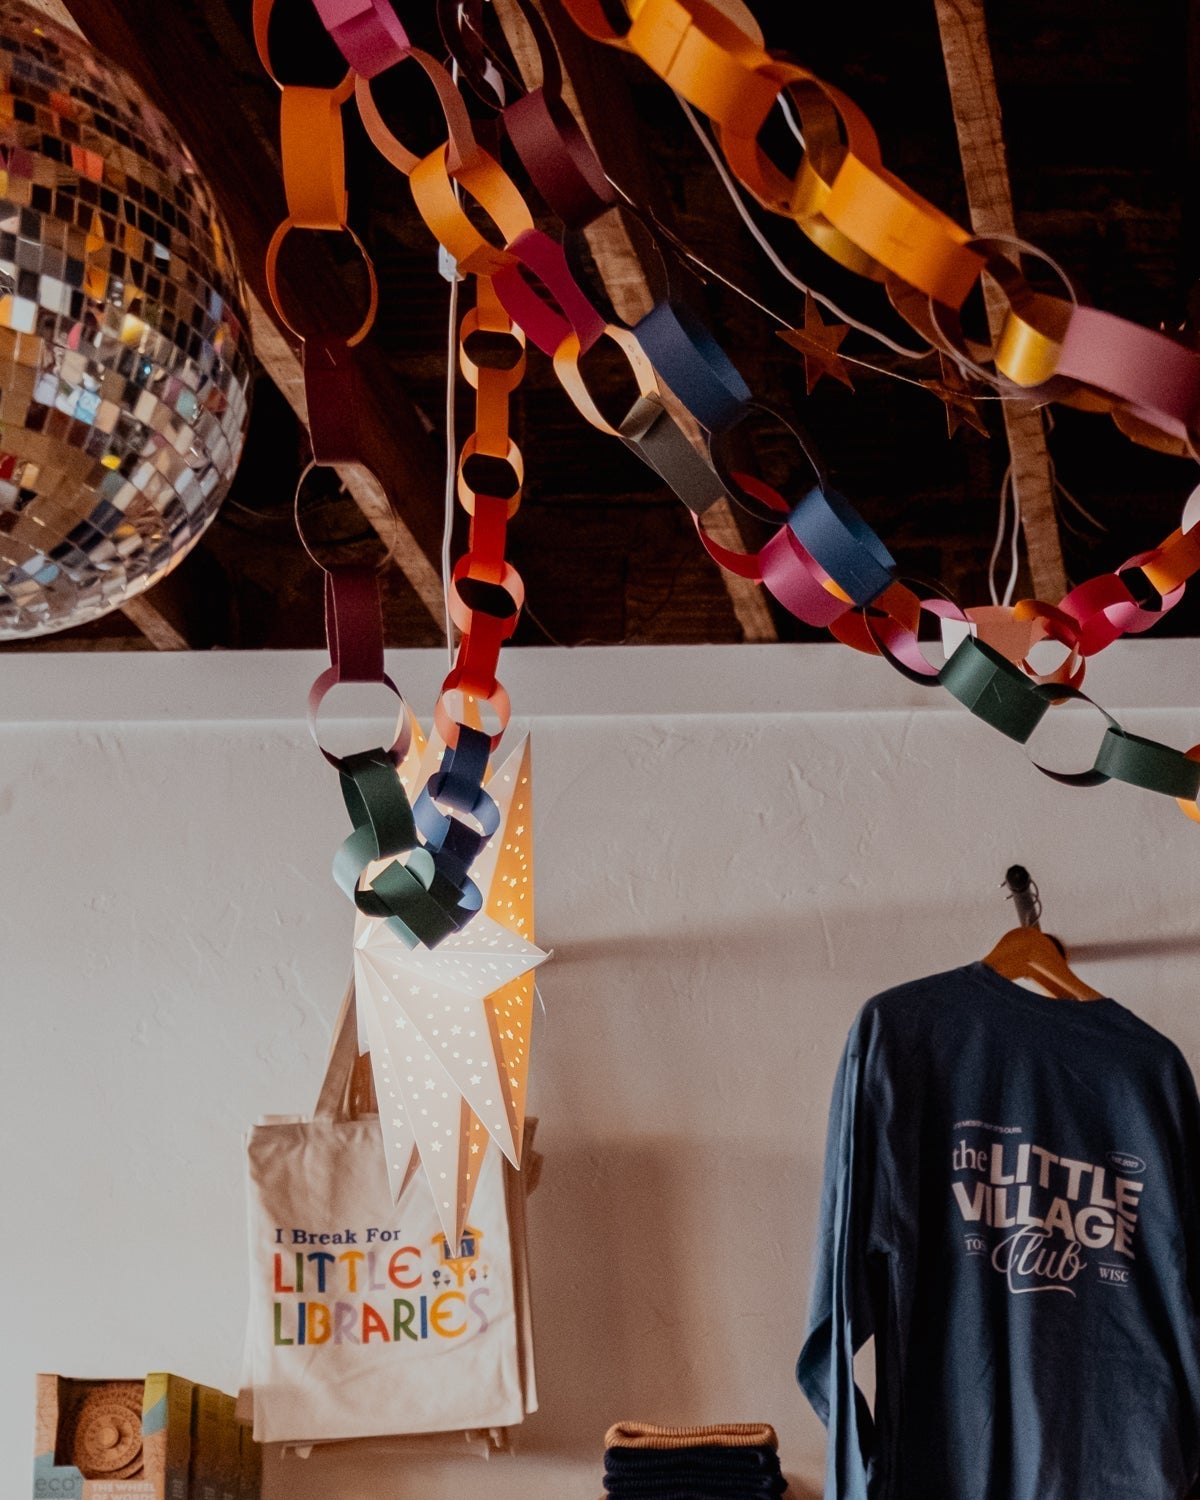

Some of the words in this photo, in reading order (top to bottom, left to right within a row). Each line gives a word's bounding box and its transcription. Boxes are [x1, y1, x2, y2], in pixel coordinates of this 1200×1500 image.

[952, 1139, 988, 1172] the
[990, 1143, 1143, 1223] LITTLE
[275, 1228, 283, 1245] I
[291, 1228, 357, 1245] Break
[366, 1227, 401, 1243] For
[952, 1182, 1136, 1260] VILLAGE
[964, 1237, 988, 1251] TOS
[274, 1246, 422, 1294] LITTLE
[992, 1224, 1087, 1298] Club
[1099, 1266, 1129, 1283] WISC
[274, 1288, 490, 1346] LIBRARIES
